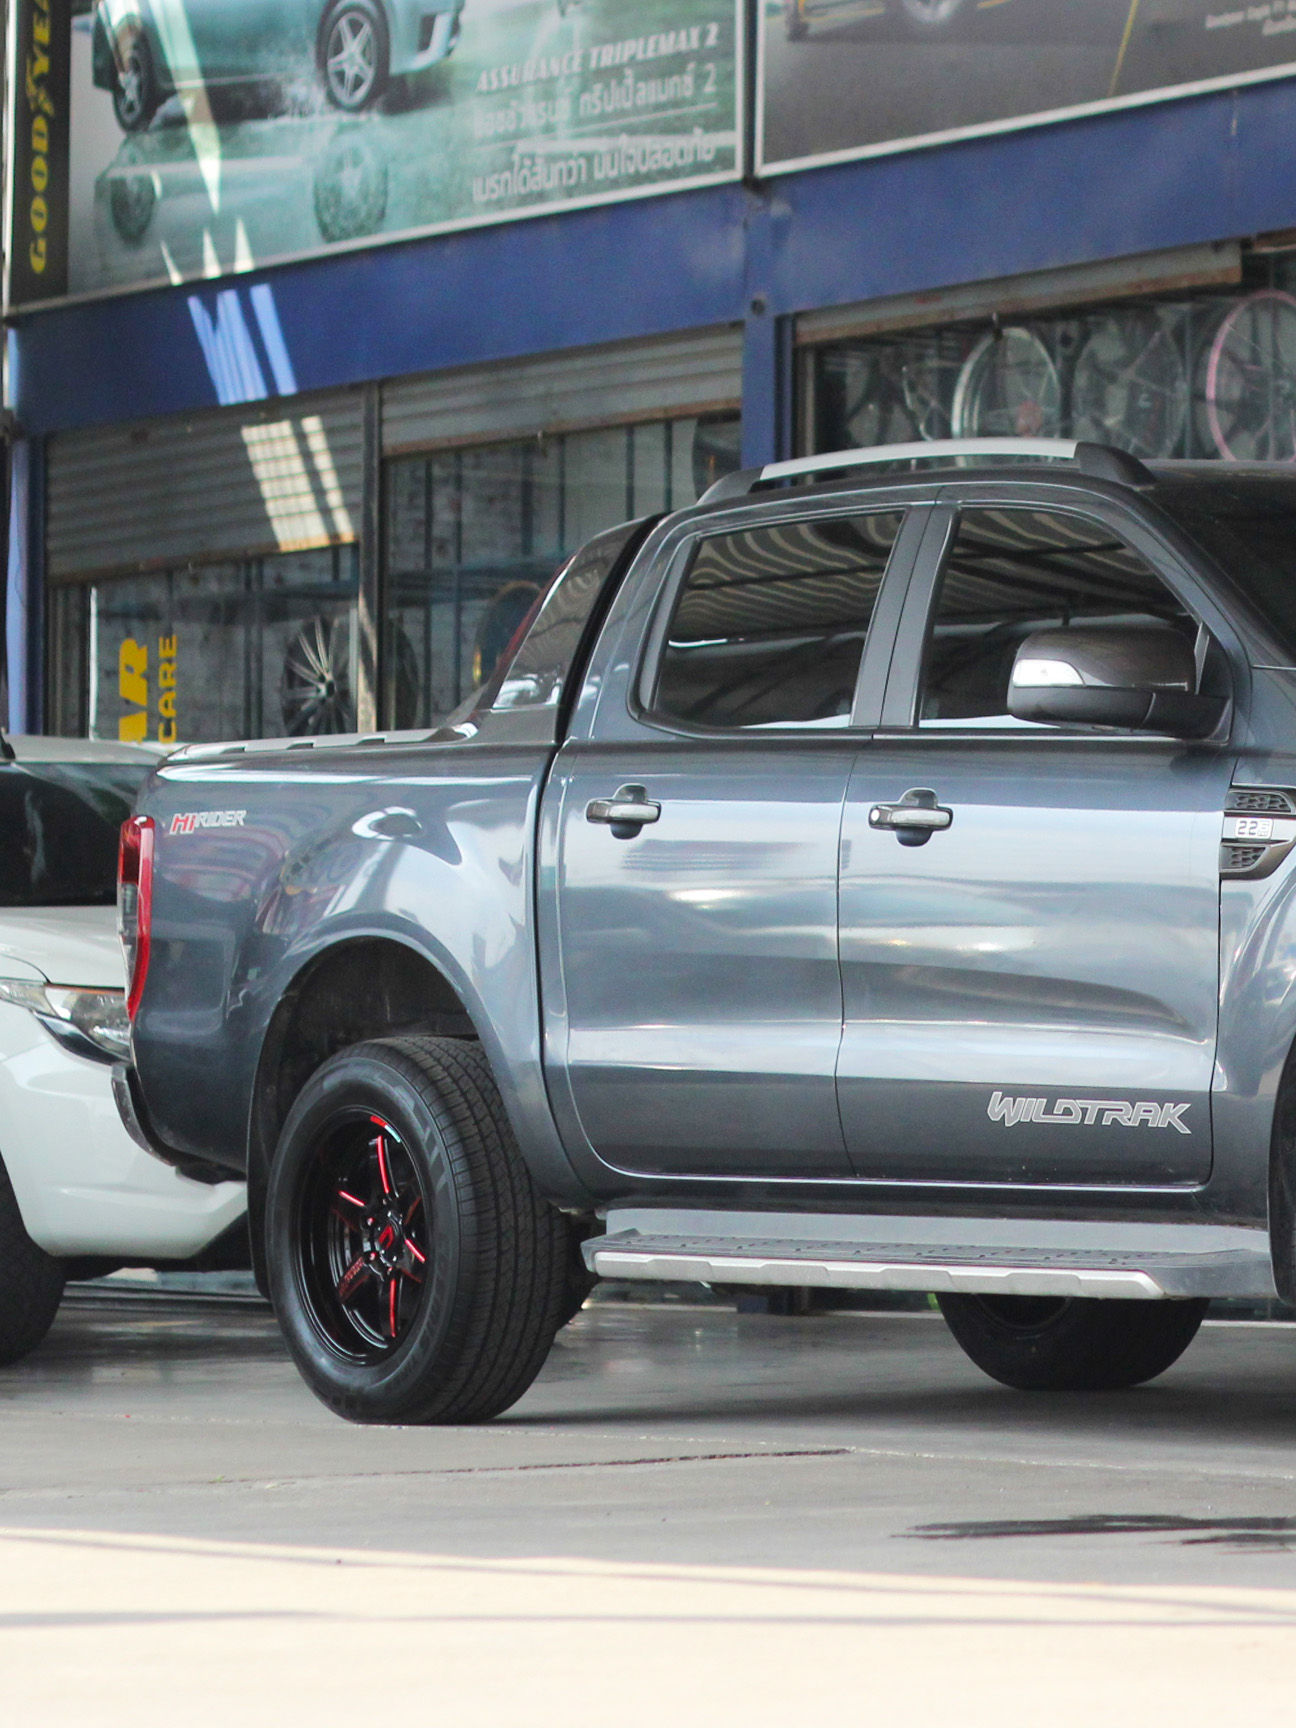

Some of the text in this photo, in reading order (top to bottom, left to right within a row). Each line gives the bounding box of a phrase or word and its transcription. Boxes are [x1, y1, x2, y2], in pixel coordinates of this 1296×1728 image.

[476, 21, 719, 92] ASSURANCE TRIPLEMAX 2
[703, 63, 717, 93] 2
[29, 0, 55, 274] GOODYE
[987, 1091, 1192, 1134] WILDTRAK
